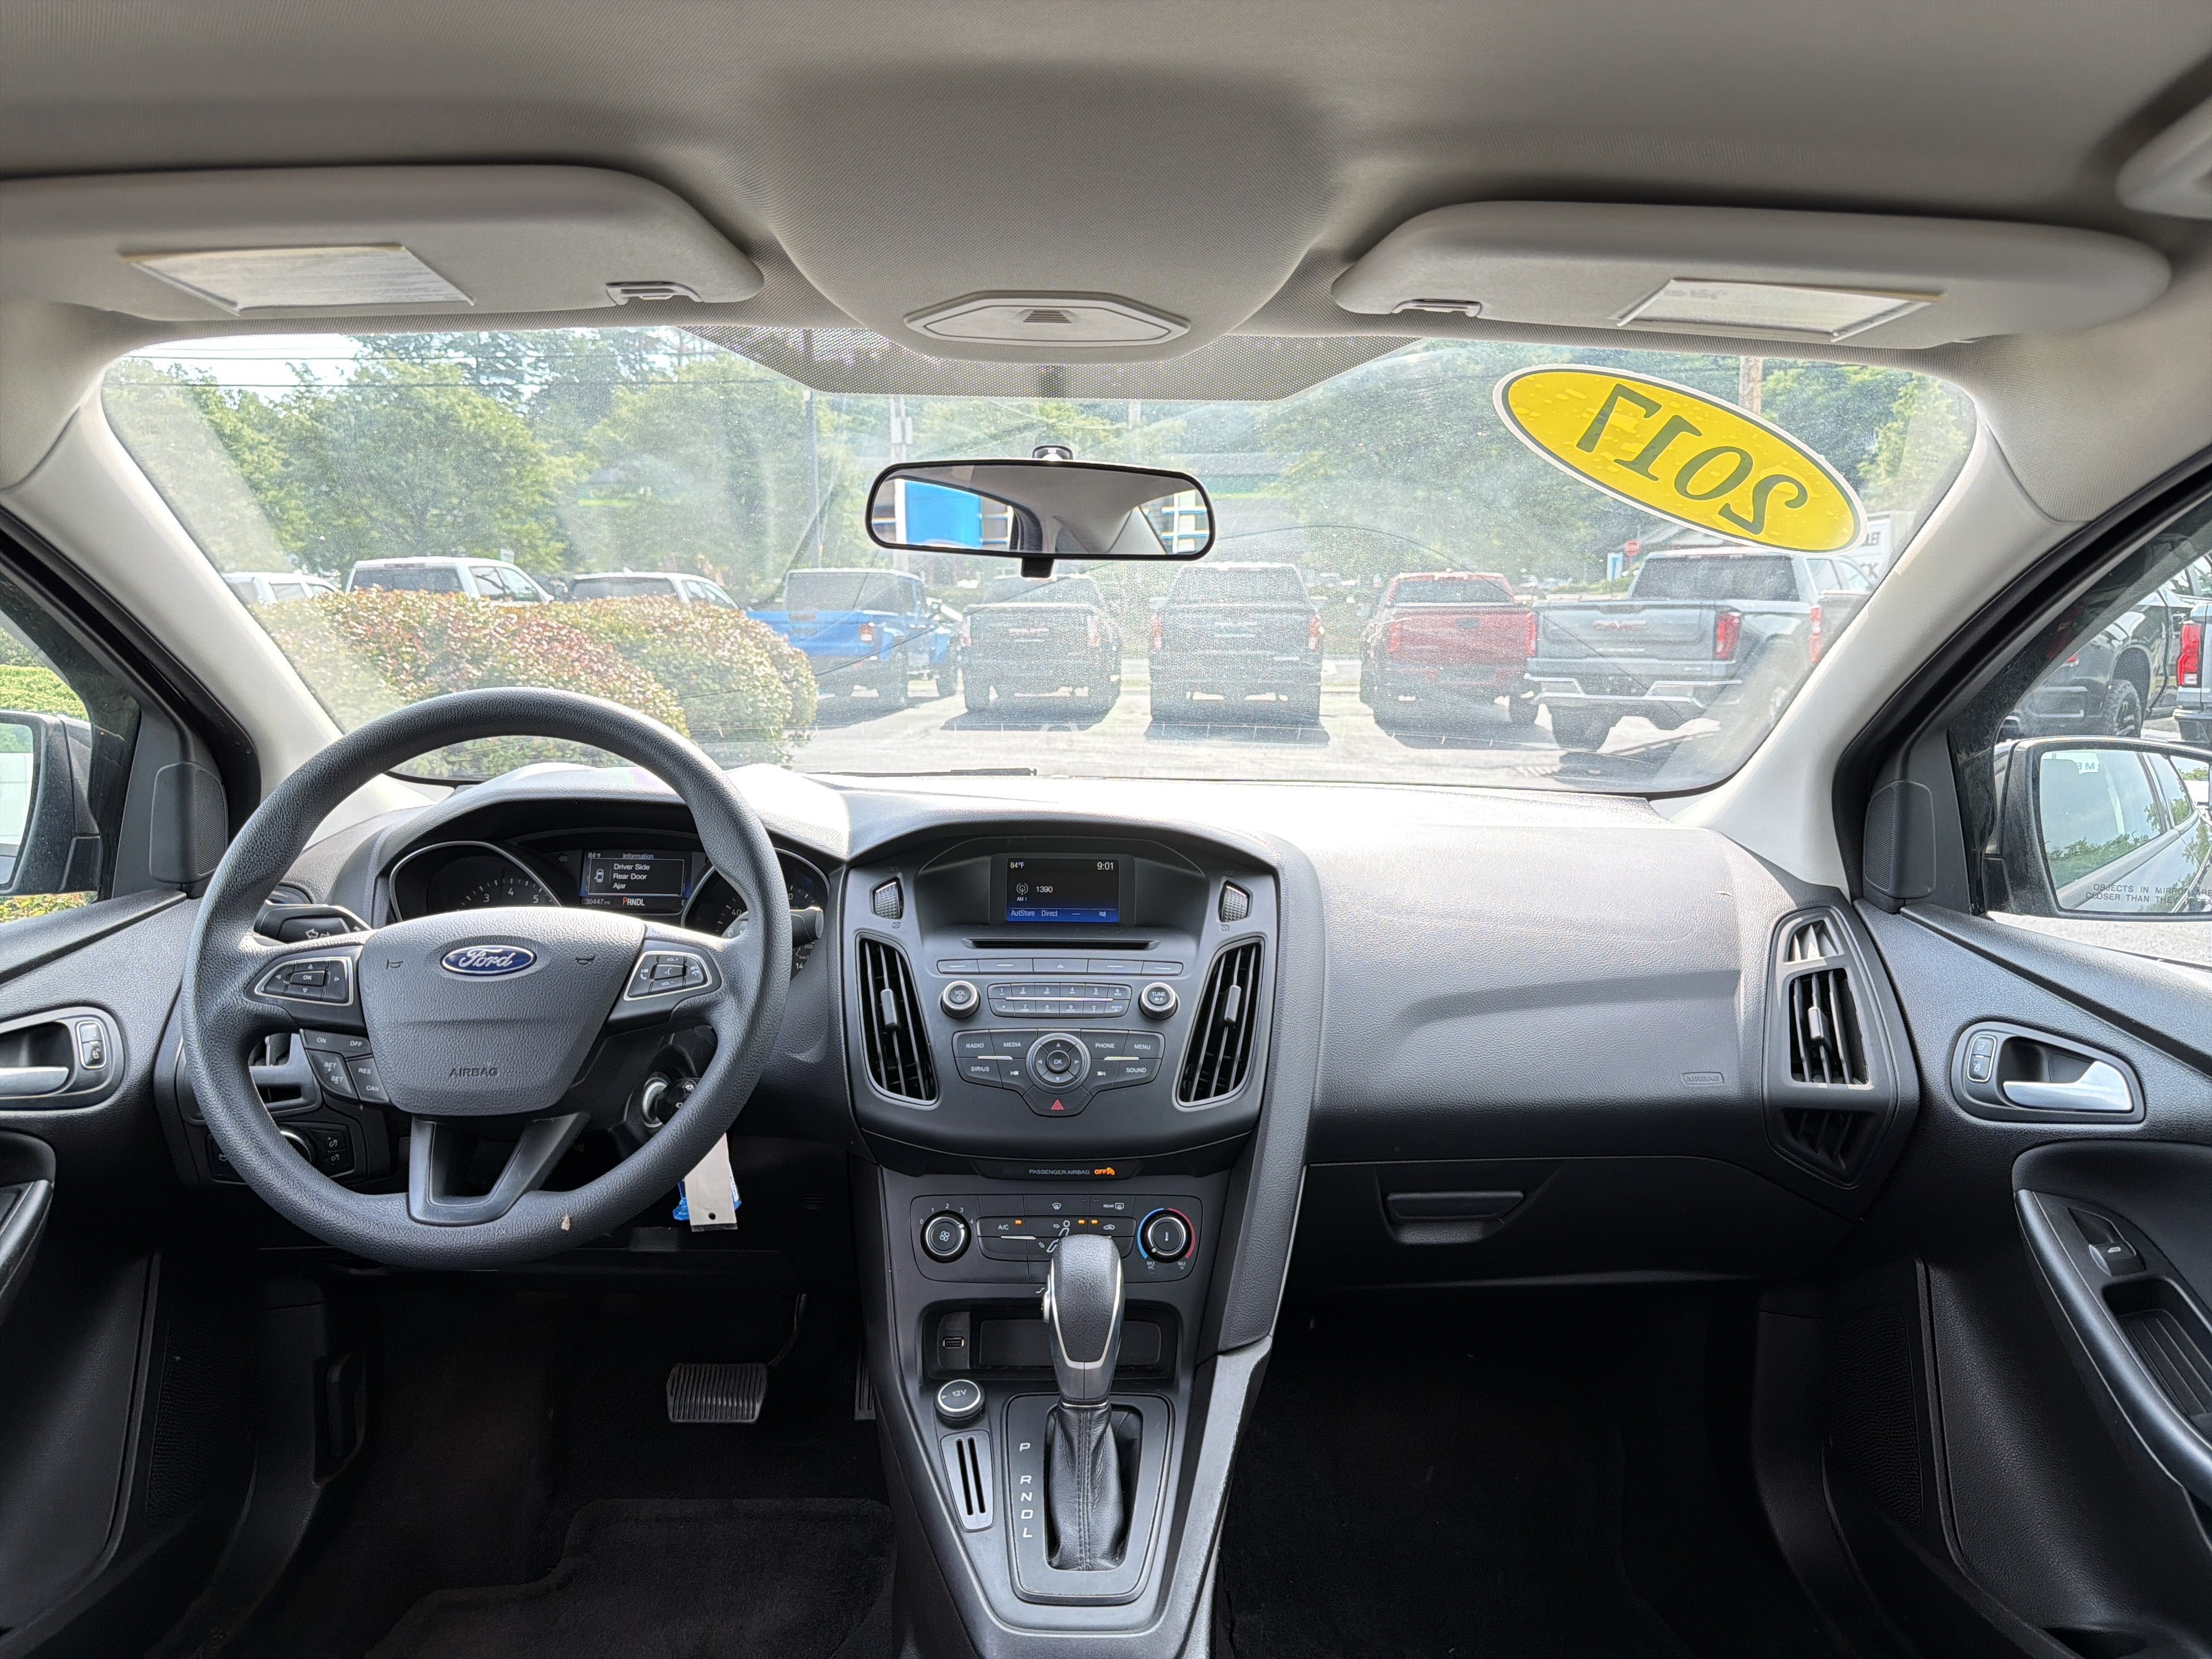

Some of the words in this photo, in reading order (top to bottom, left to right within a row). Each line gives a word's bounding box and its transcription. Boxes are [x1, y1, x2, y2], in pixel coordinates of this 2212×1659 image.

[1097, 861, 1114, 871] 9:01
[508, 887, 514, 896] 4
[2093, 883, 2134, 893] OBJECTS
[483, 894, 489, 902] 3
[533, 895, 539, 903] 5
[623, 897, 645, 906] PRNDL
[2085, 891, 2120, 901] CLOSER
[2126, 894, 2149, 902] THAN
[2155, 896, 2179, 904] THEY
[731, 909, 741, 917] 40
[459, 948, 516, 967] Ford
[449, 1068, 499, 1078] AIRBAG
[952, 1389, 967, 1397] 12V
[1019, 1442, 1030, 1452] P
[1020, 1475, 1032, 1485] R
[1020, 1492, 1032, 1502] N
[1021, 1509, 1034, 1519] D
[1022, 1527, 1032, 1538] L
